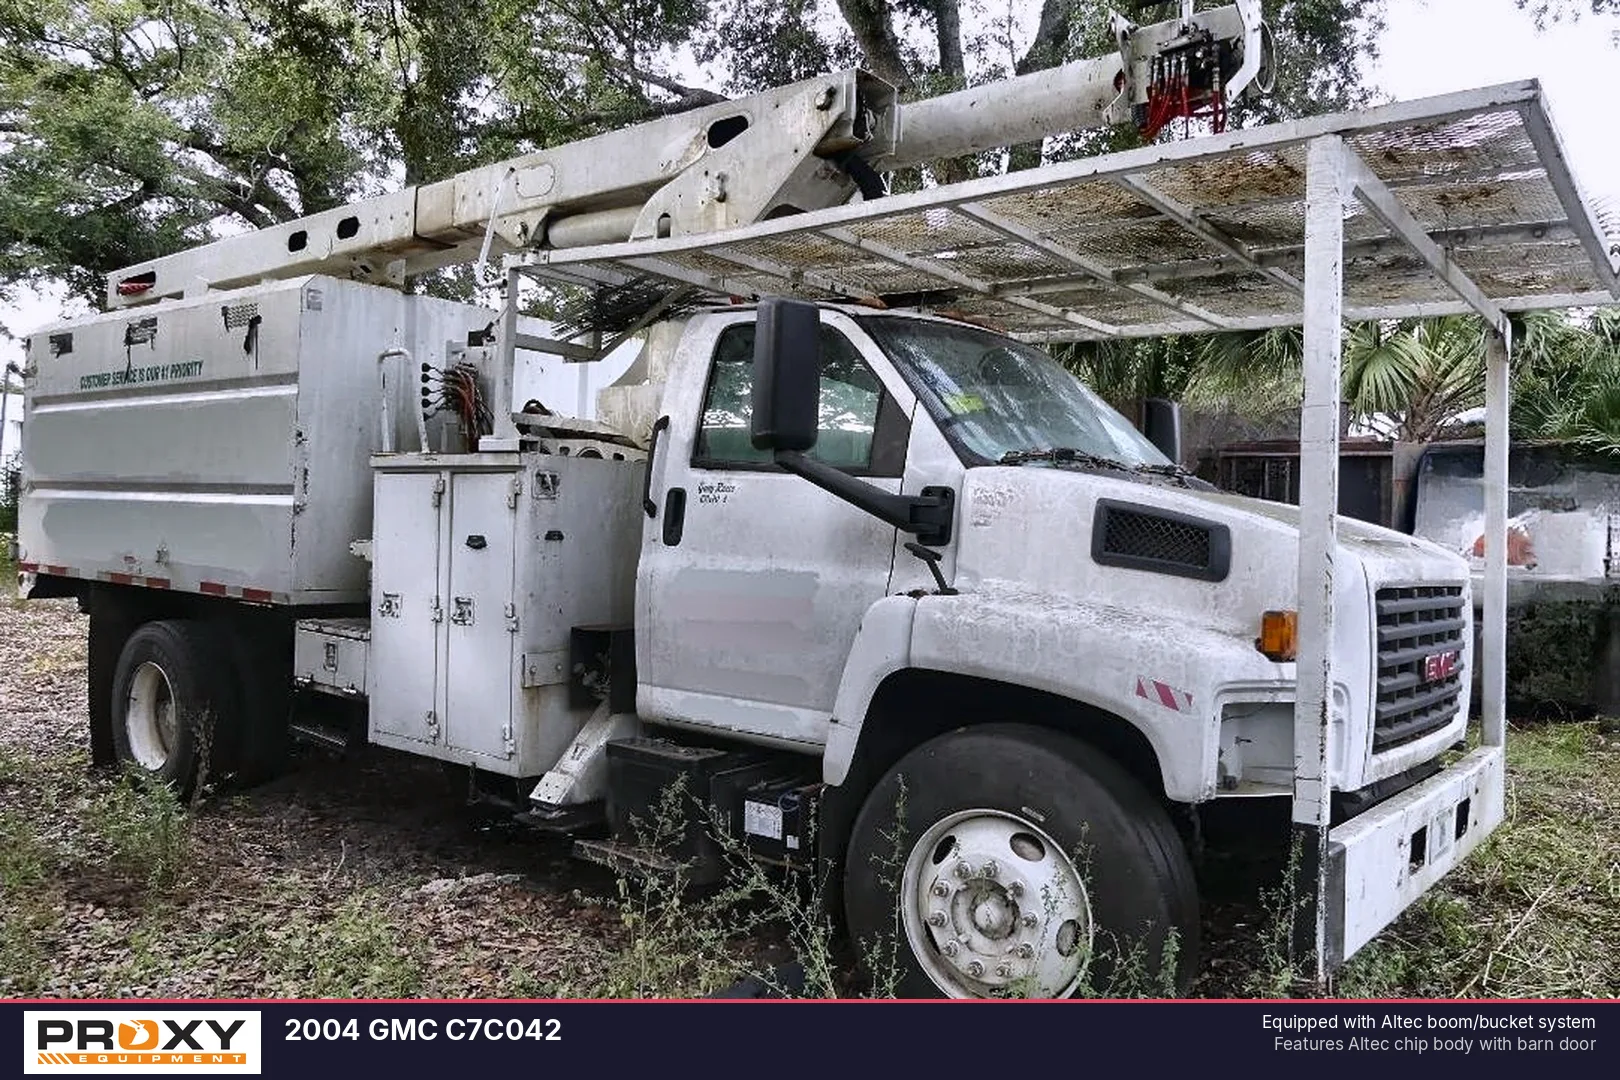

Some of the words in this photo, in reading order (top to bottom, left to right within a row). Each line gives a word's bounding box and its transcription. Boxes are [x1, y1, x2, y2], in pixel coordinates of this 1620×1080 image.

[80, 373, 111, 390] CUSTOMER
[138, 368, 146, 382] IS
[147, 365, 161, 382] OUR
[171, 360, 204, 378] PRIORITY
[1426, 653, 1459, 680] GMC
